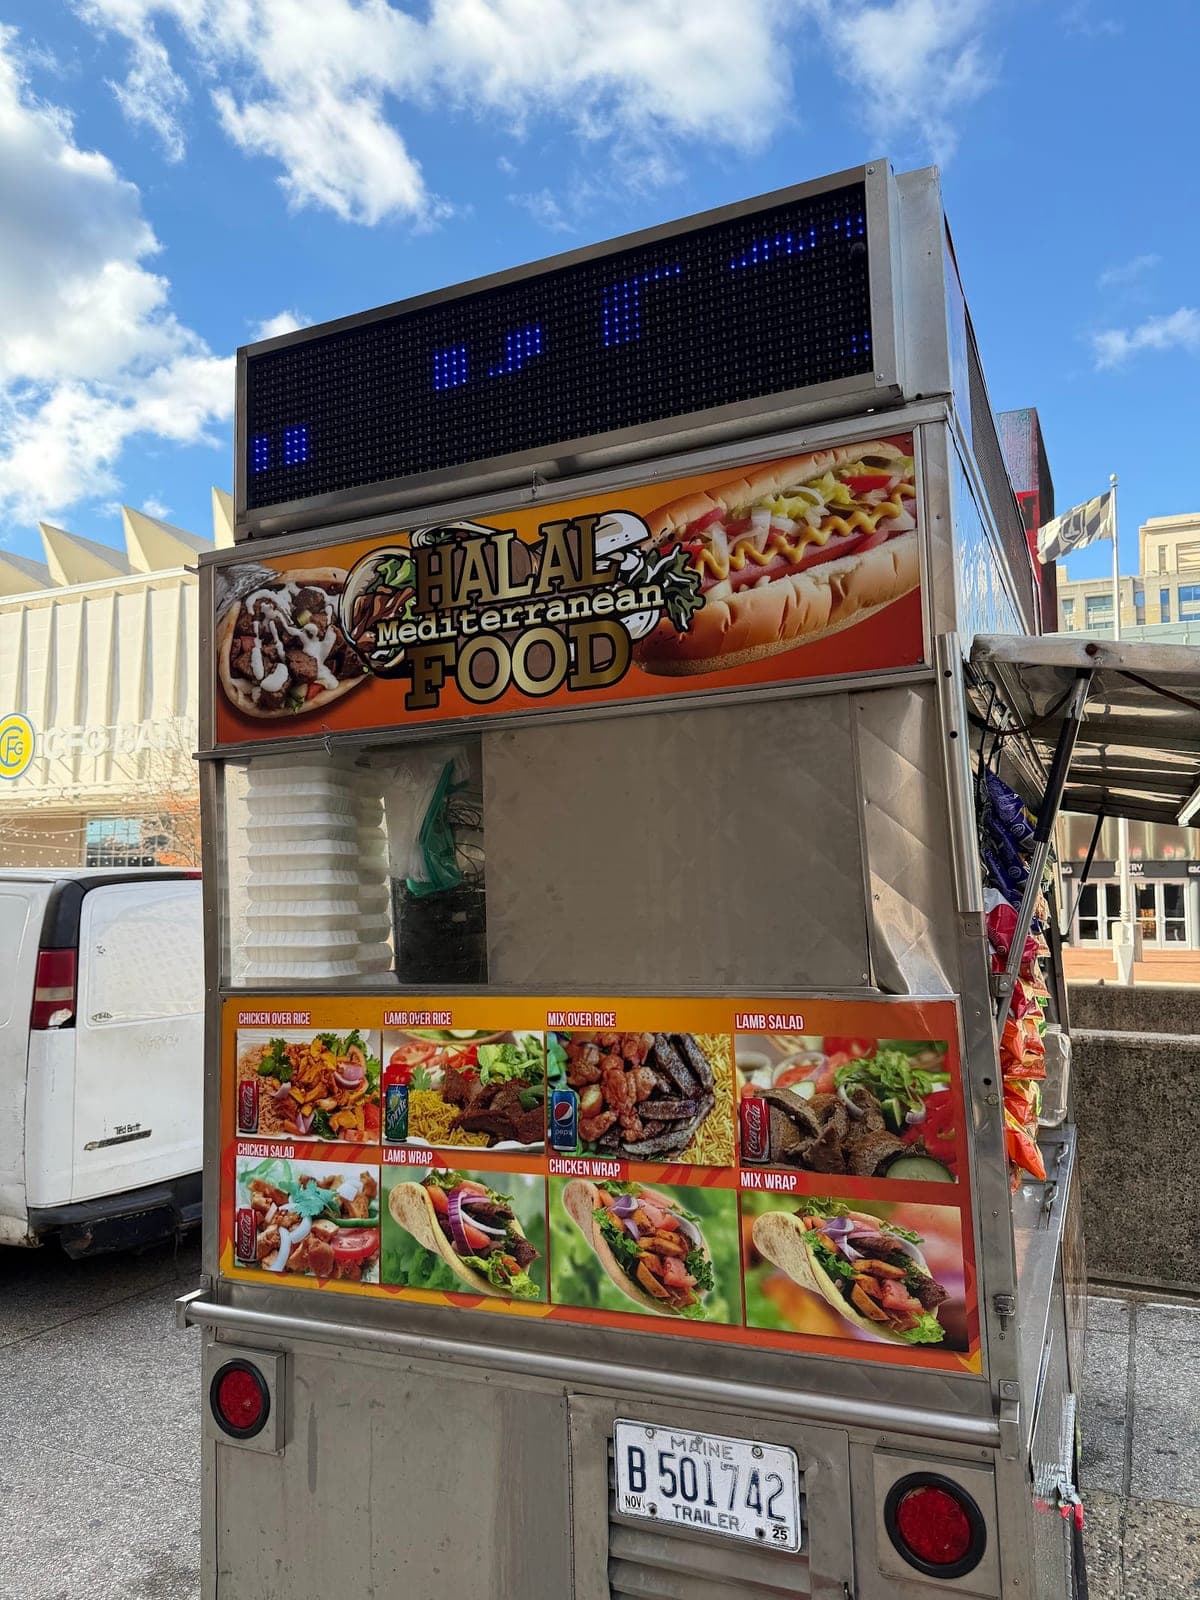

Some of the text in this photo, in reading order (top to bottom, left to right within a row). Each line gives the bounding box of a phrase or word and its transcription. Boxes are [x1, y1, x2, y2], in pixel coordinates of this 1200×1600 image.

[413, 515, 621, 614] HALAL
[376, 584, 665, 648] Mediterranean
[405, 619, 632, 711] FOOD
[238, 1012, 311, 1025] CHICKEN OVER RICE
[384, 1012, 452, 1025] LAMB OVER RICE
[547, 1012, 616, 1027] MIX OVER RICE
[736, 1014, 804, 1030] LAMB SALAD
[237, 1143, 295, 1159] CHICKEN SALAD
[383, 1149, 433, 1165] LAMB WRAP
[549, 1158, 621, 1177] CHICKEN WRAP
[740, 1172, 797, 1190] MIX WRAP
[671, 1435, 733, 1460] MAINE
[624, 1495, 643, 1508] NOV
[672, 1503, 739, 1531] TRAILER
[772, 1529, 788, 1541] 25
